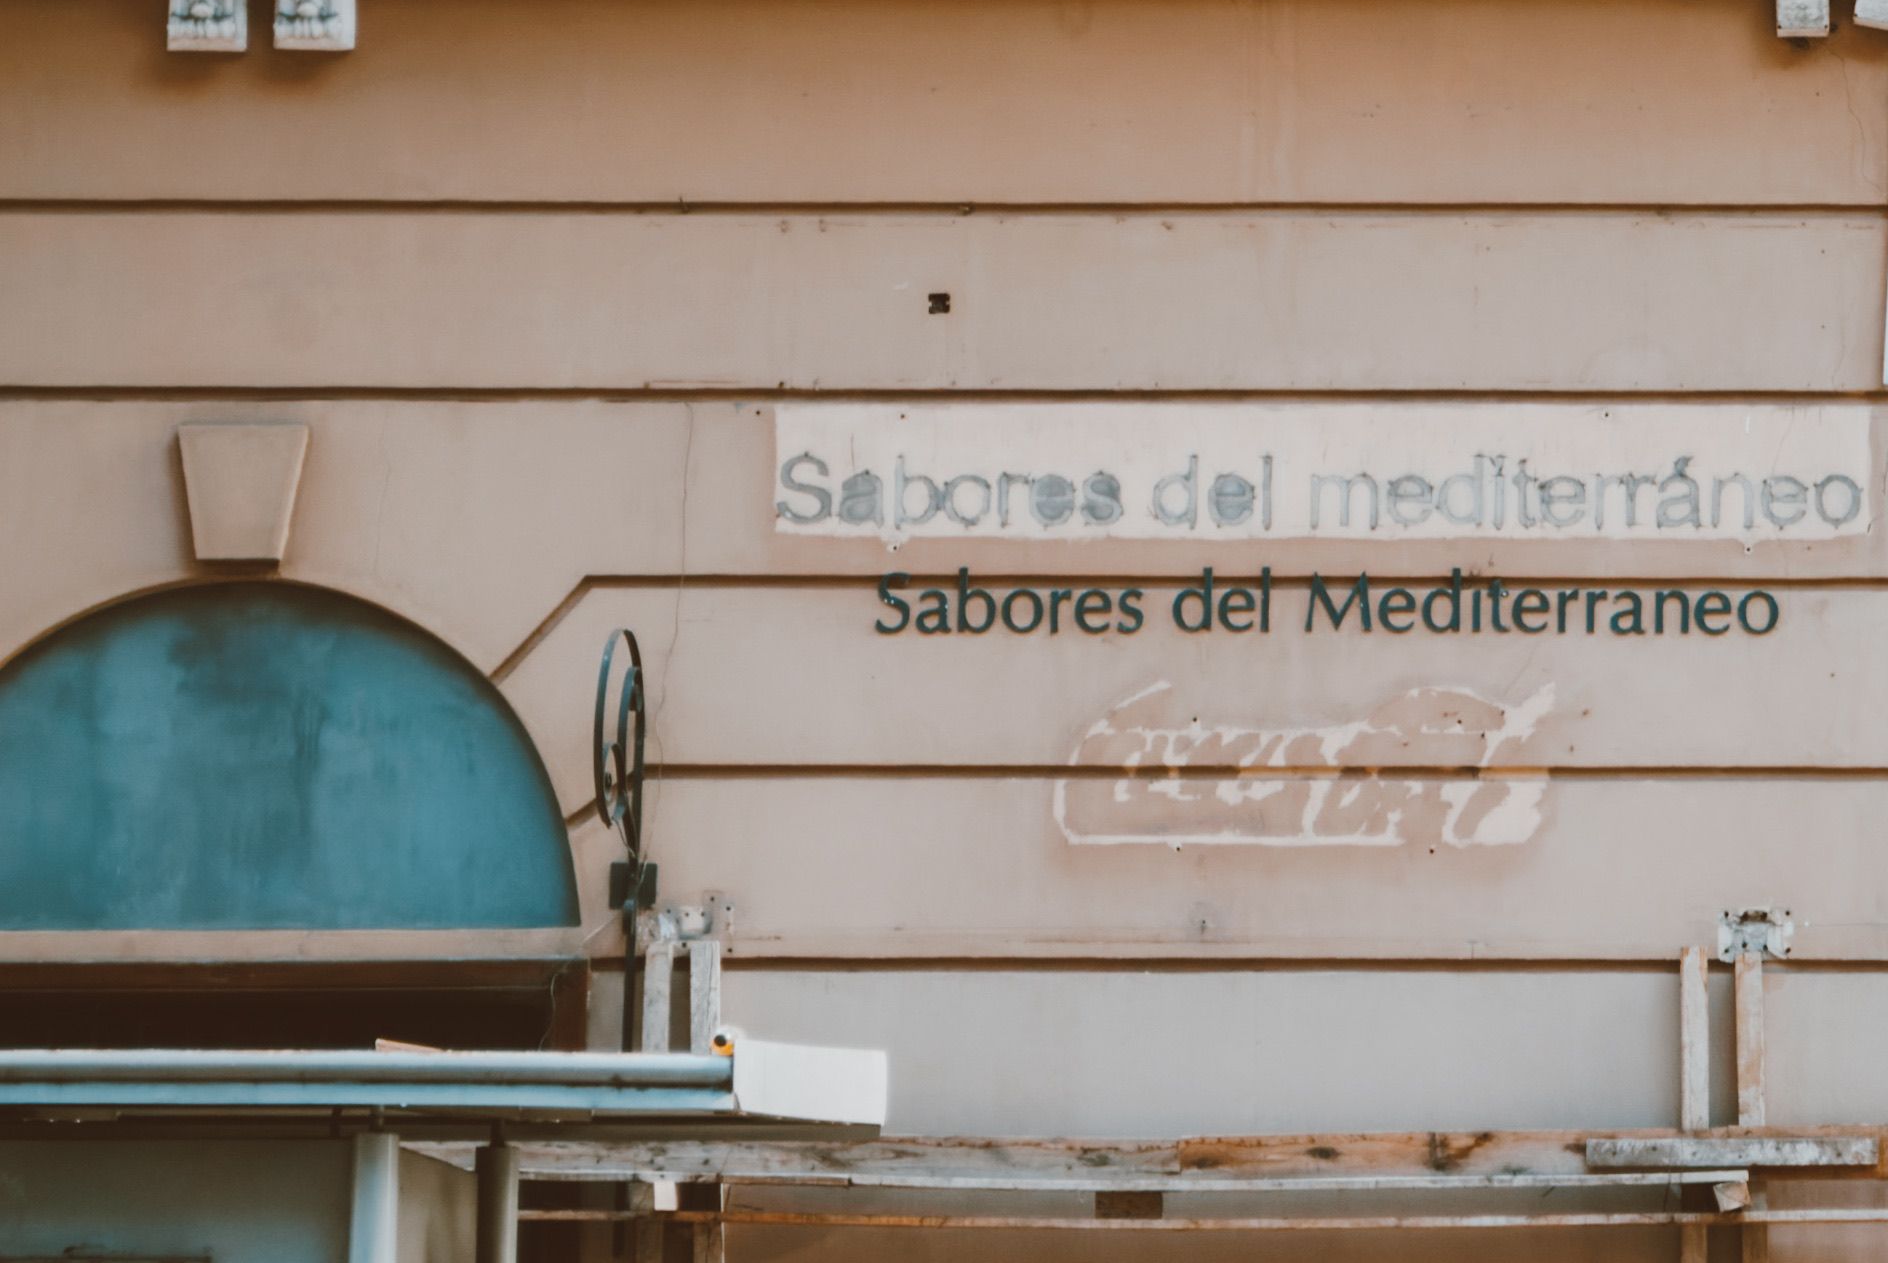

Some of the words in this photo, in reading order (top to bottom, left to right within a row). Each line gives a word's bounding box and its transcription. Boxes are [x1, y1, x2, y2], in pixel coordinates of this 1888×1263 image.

[777, 452, 1124, 530] Sabores
[1150, 453, 1273, 531] del
[1310, 453, 1864, 531] mediterráneo
[875, 567, 1144, 635] Sabores
[1172, 567, 1271, 634] del
[1304, 567, 1780, 635] Mediterraneo
